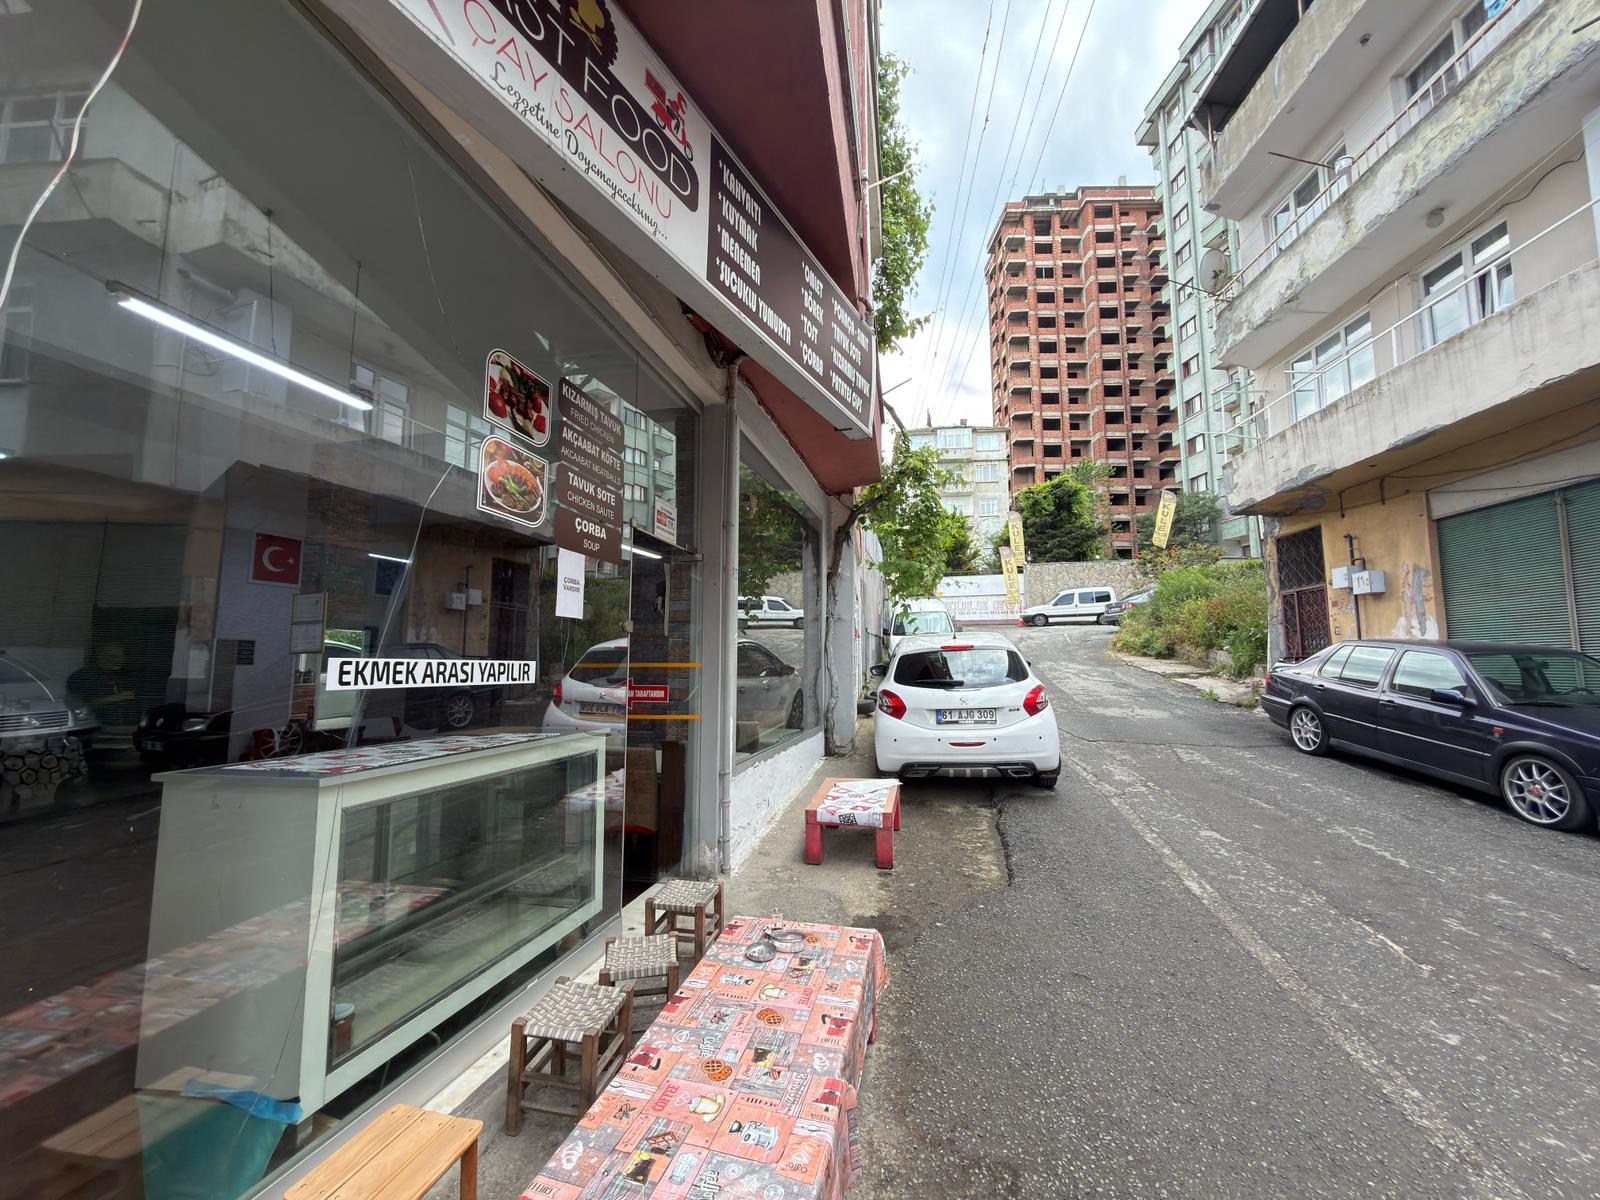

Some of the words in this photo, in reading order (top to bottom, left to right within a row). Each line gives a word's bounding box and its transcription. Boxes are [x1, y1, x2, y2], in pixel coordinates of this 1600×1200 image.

[464, 0, 549, 92] ÇAY
[555, 88, 672, 219] SALONU
[489, 60, 561, 139] Lezzetine
[584, 56, 691, 196] FOOD
[723, 163, 762, 226] KAHVALTI
[722, 195, 758, 252] KUYMAK
[721, 227, 761, 286] MENEMEN
[804, 264, 824, 299] OMLET
[719, 260, 757, 313] SUCUKLU
[758, 297, 791, 346] YUMURTA
[804, 287, 824, 326] BÖREK
[803, 315, 819, 345] TOST
[802, 343, 824, 377] ÇORBA
[562, 383, 599, 422] KIZARMIŞ
[600, 411, 622, 436] TAVUK
[570, 407, 589, 427] FRIED
[589, 421, 615, 444] CHICKEN
[562, 426, 600, 457] AKÇAABAT
[568, 471, 595, 497] TAVUK
[597, 487, 616, 506] SOTE
[592, 463, 622, 486] MEATBALLS
[567, 491, 595, 512] CHICKEN
[595, 504, 615, 520] SAUTE
[575, 517, 607, 540] ÇORBA
[583, 539, 600, 552] SOUP
[338, 660, 418, 687] EKMEK
[421, 661, 475, 684] ARASI
[478, 662, 531, 683] YAPILIR
[942, 709, 952, 720] 61
[958, 709, 975, 719] AJG
[977, 709, 994, 719] 309
[652, 1083, 679, 1112] COFFEE
[785, 1160, 808, 1174] Coffee
